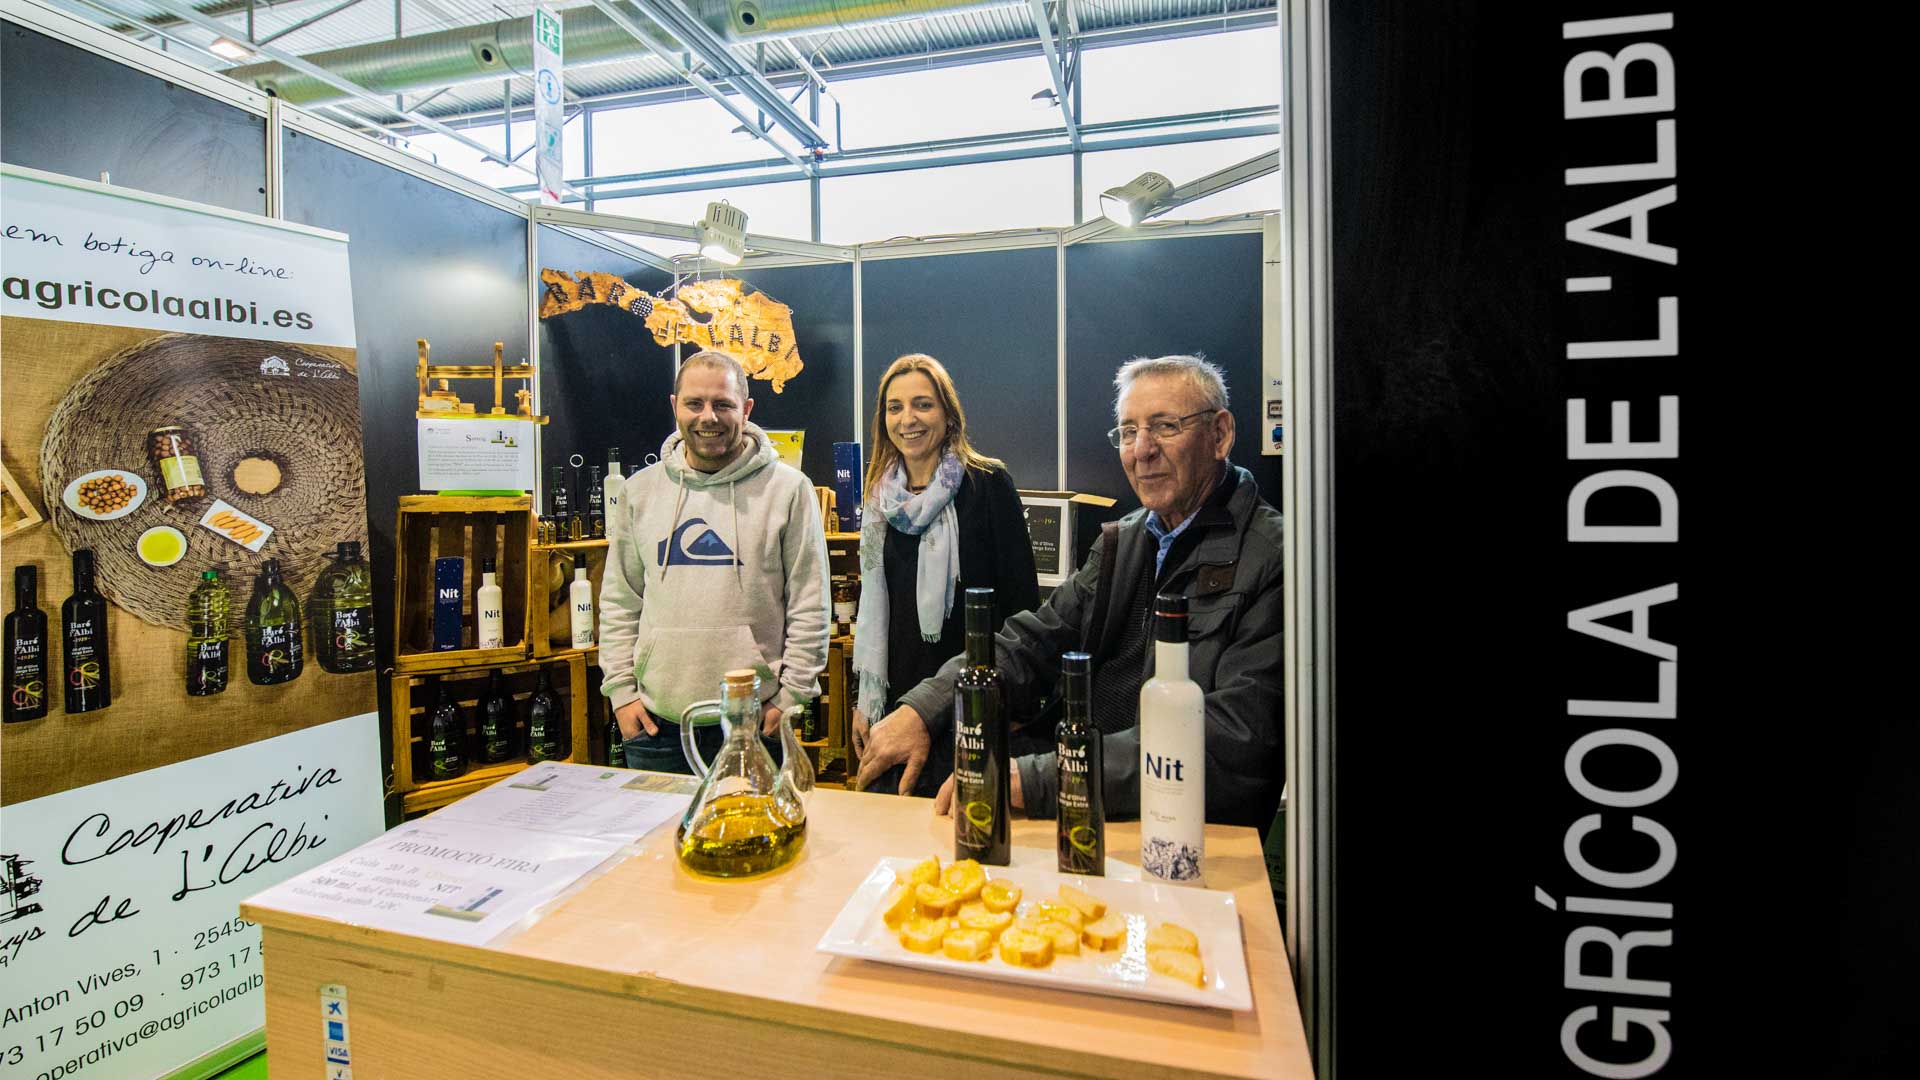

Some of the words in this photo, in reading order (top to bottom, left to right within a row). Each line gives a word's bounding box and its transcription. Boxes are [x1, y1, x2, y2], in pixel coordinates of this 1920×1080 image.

[1563, 13, 1678, 359] L'ALBI
[84, 232, 173, 275] botiga
[2, 277, 313, 330] agricolaalbi.es
[837, 469, 851, 478] Nit
[1567, 395, 1679, 542] DE
[440, 588, 460, 599] Nit
[577, 603, 592, 612] Nit
[70, 619, 91, 629] Baró
[485, 609, 501, 619] Nit
[16, 637, 39, 646] Baró
[1057, 742, 1086, 758] Baró
[1146, 752, 1184, 782] Nit
[62, 765, 342, 865] Cooperativa
[388, 840, 494, 866] PROMOCIÓ
[493, 856, 546, 875] FIRA
[69, 896, 141, 938] de
[2, 988, 70, 1028] Anton
[77, 961, 142, 996] Vives,
[153, 949, 161, 966] 1
[35, 1026, 65, 1053] 17
[75, 1010, 106, 1037] 50
[113, 993, 145, 1020] 09
[180, 960, 221, 991] 973
[229, 946, 251, 969] 17
[329, 1046, 348, 1057] VISA
